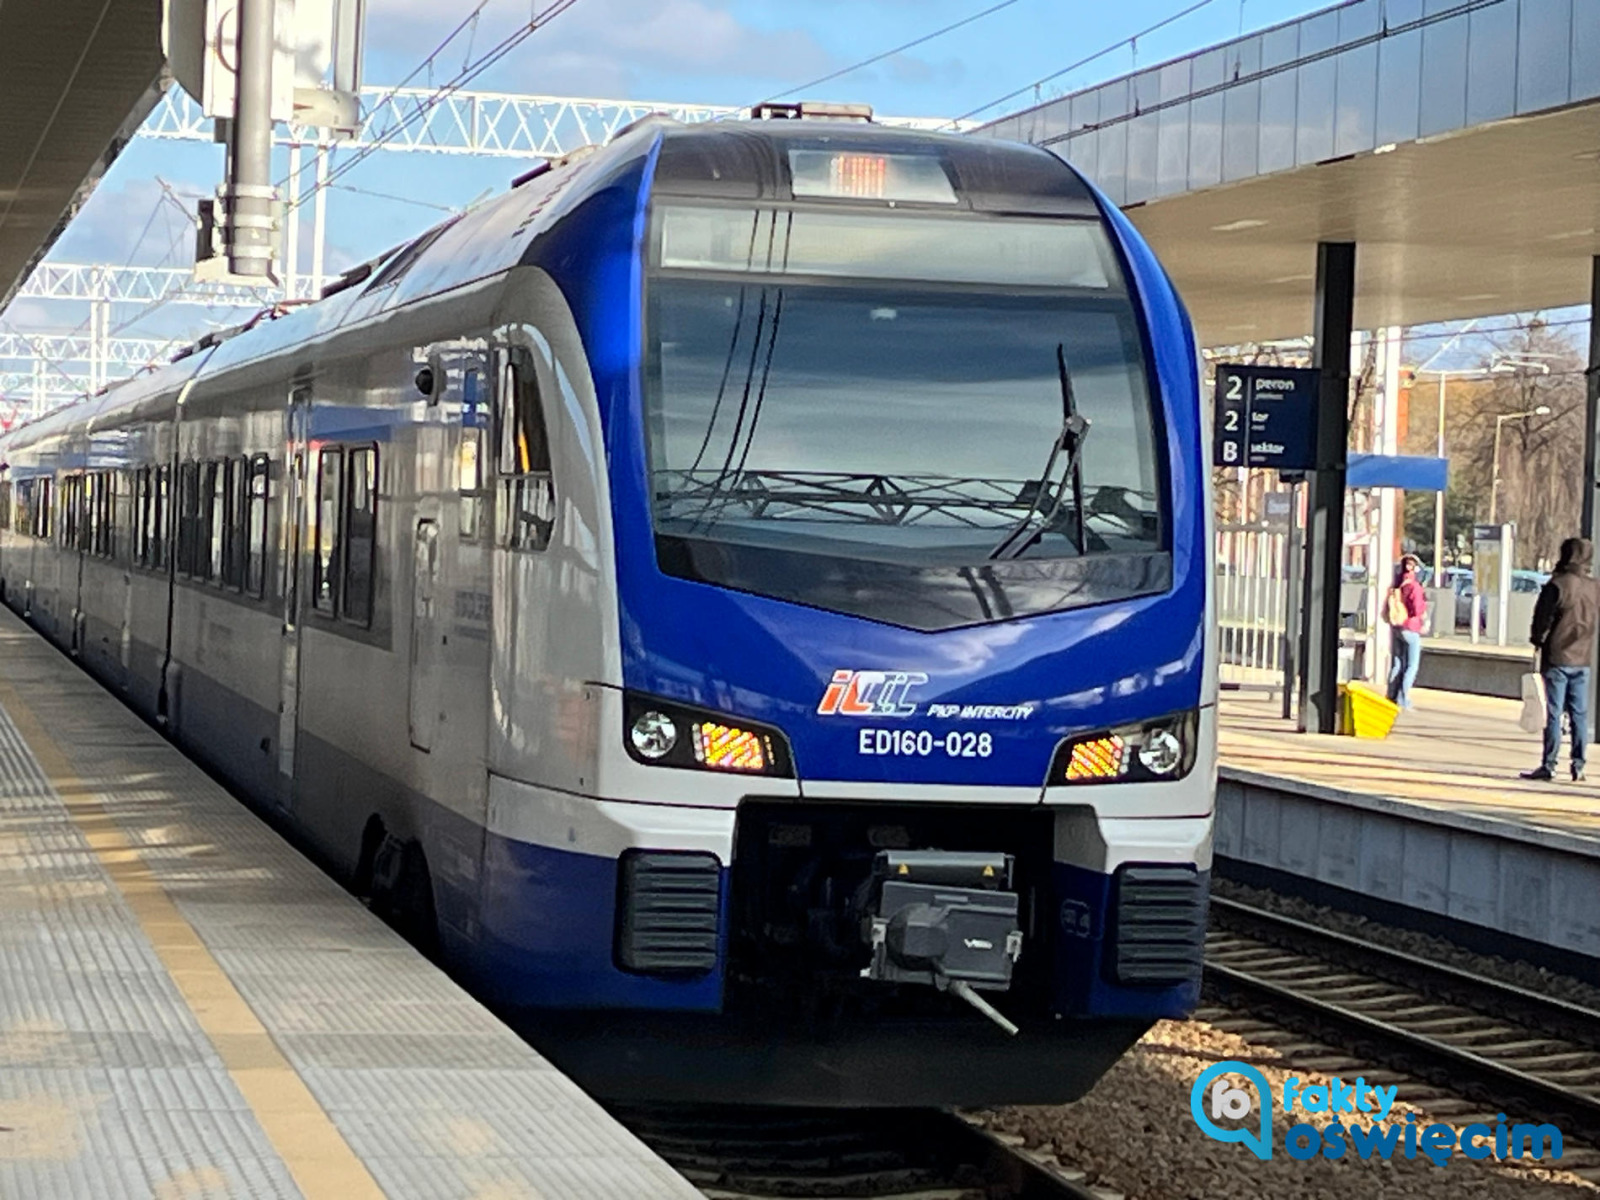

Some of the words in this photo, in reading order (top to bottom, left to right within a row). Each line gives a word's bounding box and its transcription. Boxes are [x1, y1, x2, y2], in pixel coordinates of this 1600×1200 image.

[1226, 375, 1243, 400] 2
[1224, 410, 1239, 431] 2
[1222, 440, 1238, 462] B
[926, 703, 960, 718] PKP
[960, 705, 1034, 720] INTERCITY
[858, 729, 993, 757] ED160-028
